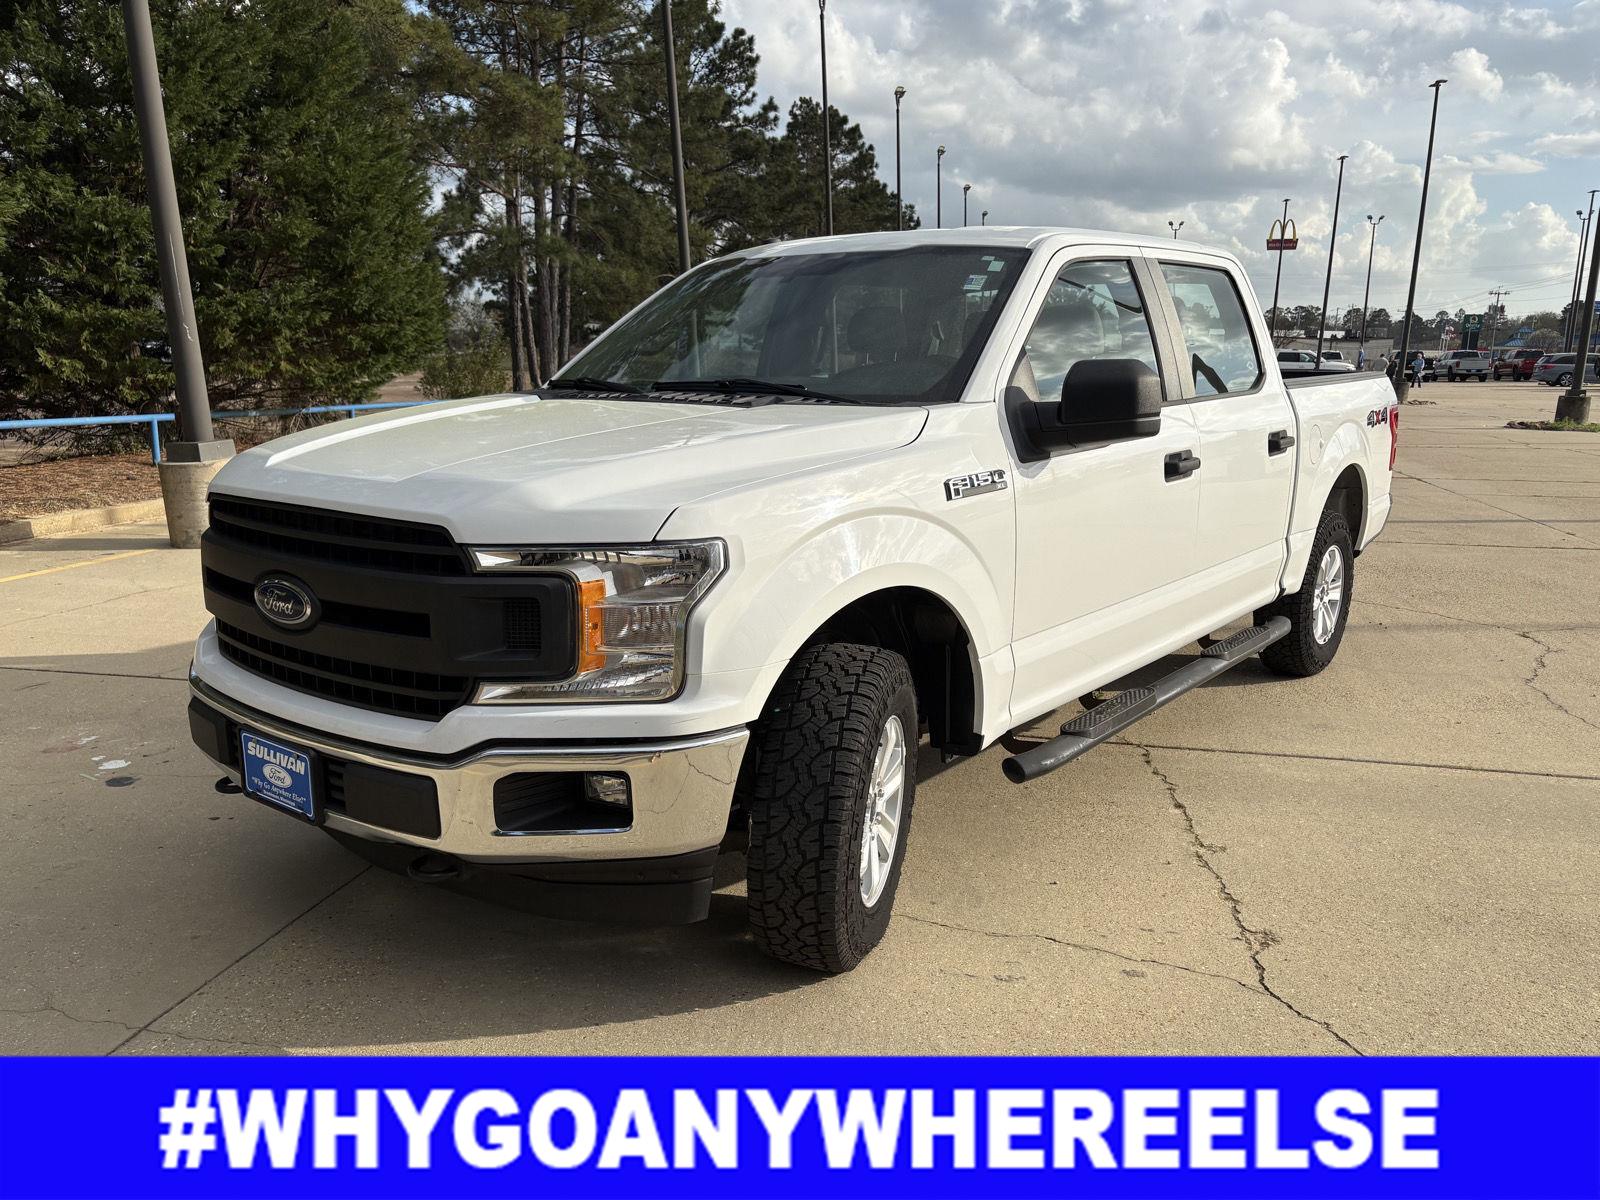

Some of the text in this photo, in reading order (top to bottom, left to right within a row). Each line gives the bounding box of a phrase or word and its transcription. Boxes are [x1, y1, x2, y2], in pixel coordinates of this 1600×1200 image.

[264, 588, 294, 615] Ford
[247, 741, 305, 775] SULLIVAN
[268, 767, 286, 784] Ford
